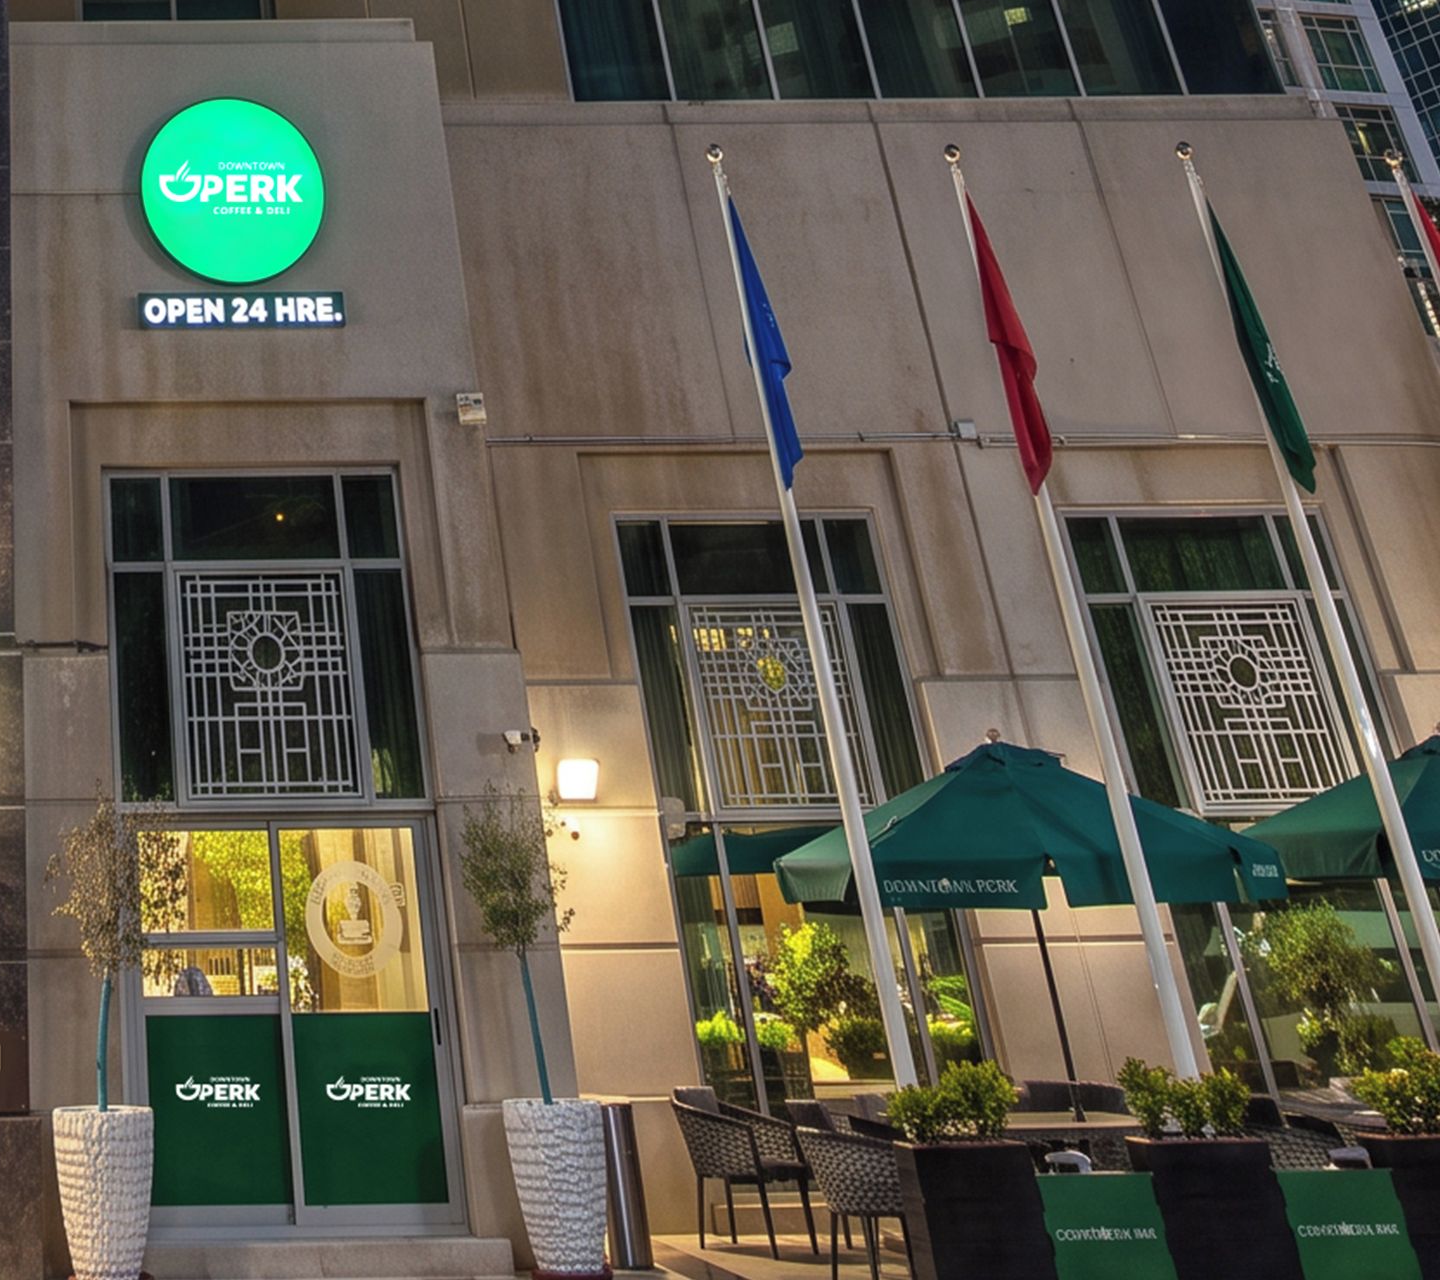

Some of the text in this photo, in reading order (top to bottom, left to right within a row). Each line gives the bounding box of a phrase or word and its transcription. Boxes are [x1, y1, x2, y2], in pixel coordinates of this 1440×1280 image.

[218, 161, 285, 171] DOWNTOWN
[200, 174, 303, 202] PERK
[213, 206, 252, 215] COFFEE
[144, 297, 342, 324] OPEN 24 HRE.
[198, 1084, 260, 1101] PERK
[349, 1084, 411, 1101] PERK
